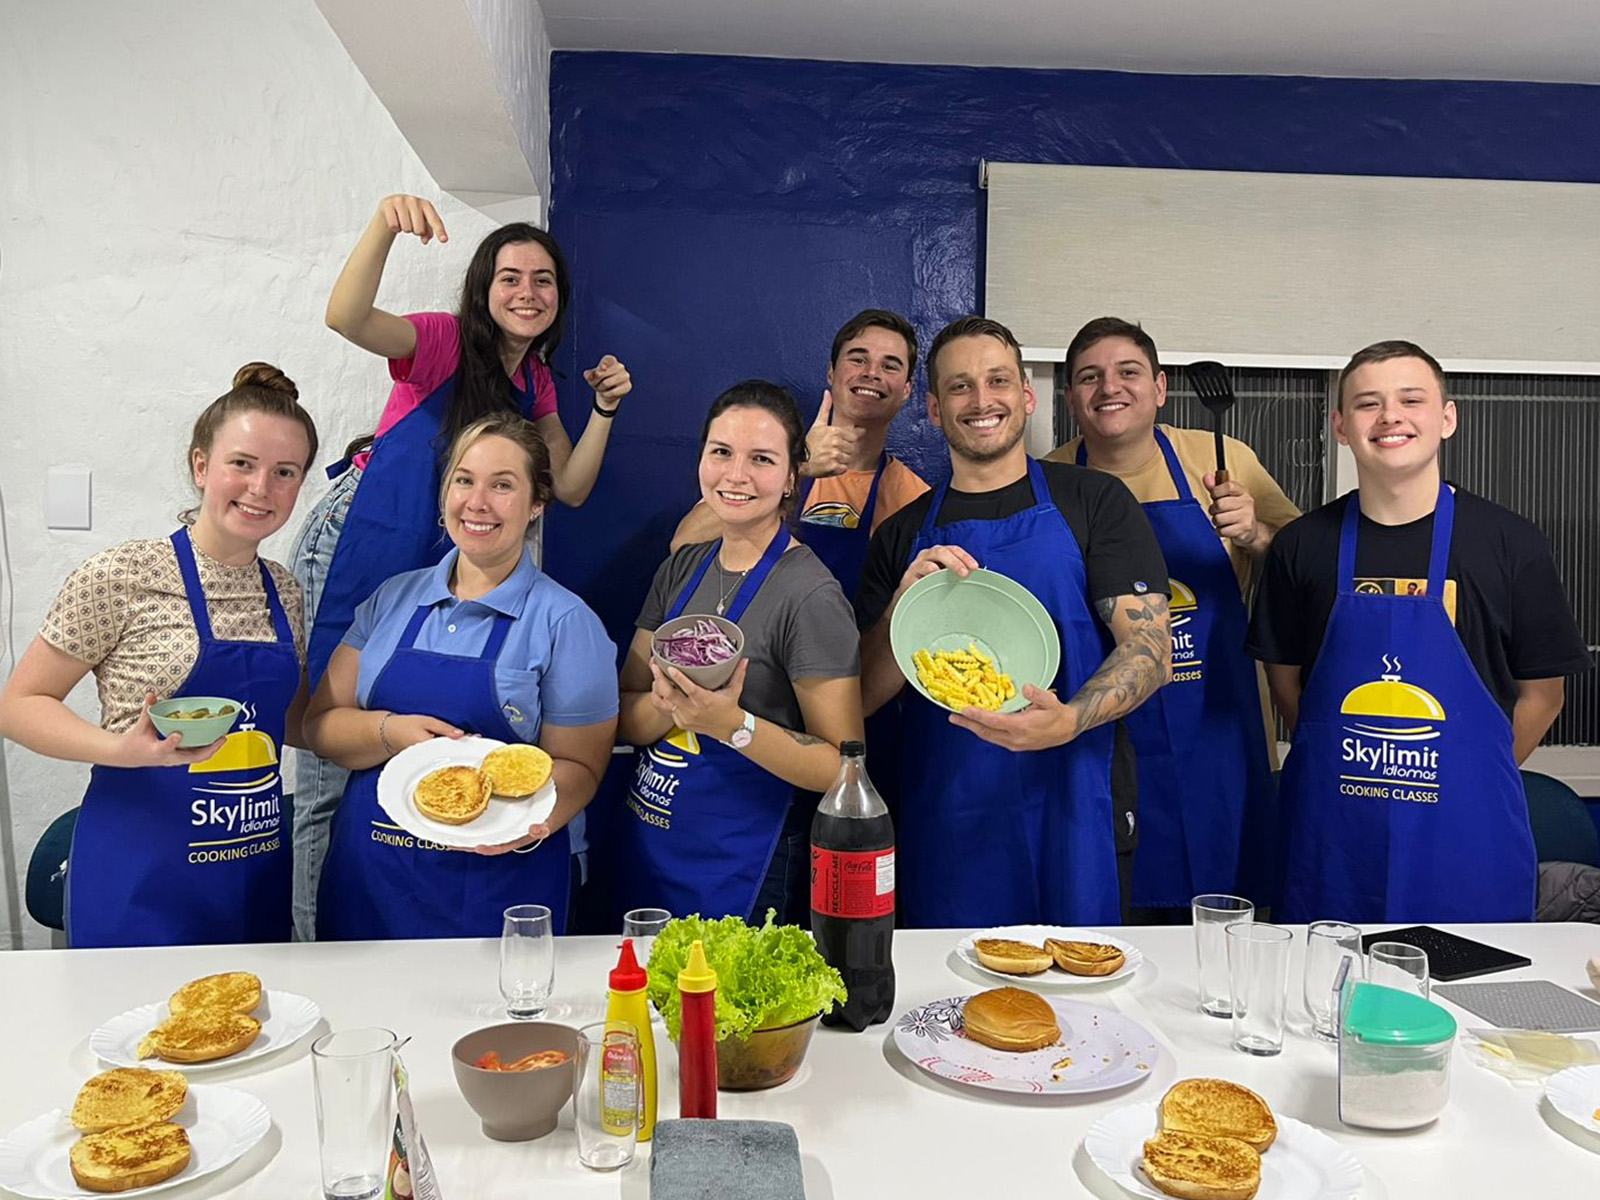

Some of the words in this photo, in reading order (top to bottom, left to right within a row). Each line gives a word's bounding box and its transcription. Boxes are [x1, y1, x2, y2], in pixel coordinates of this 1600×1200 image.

[1342, 738, 1439, 771] Skylimit
[1382, 765, 1438, 780] Idiomas
[1340, 783, 1390, 799] COOKING
[1392, 788, 1439, 803] CLASSES
[191, 793, 280, 831] Skylimit
[371, 829, 414, 848] COOKING
[416, 838, 449, 851] CLAS
[188, 846, 248, 864] COOKING
